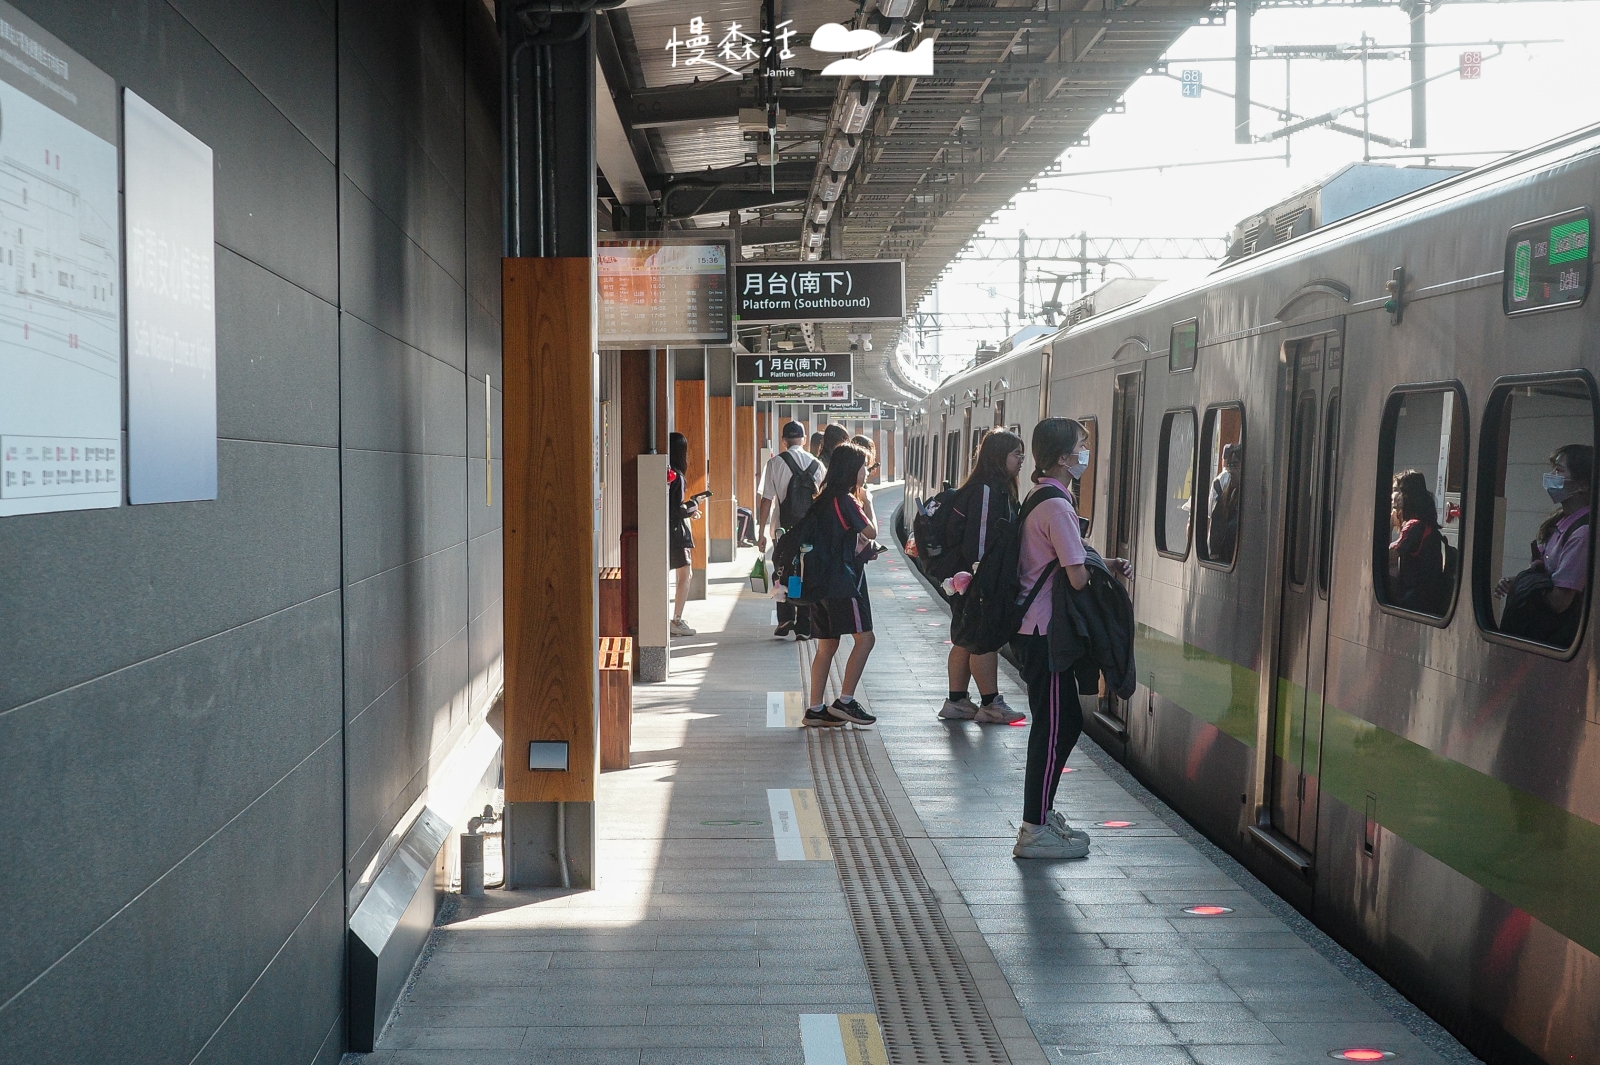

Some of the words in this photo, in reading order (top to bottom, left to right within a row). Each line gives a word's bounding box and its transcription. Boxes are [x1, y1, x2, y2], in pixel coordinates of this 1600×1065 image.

[1464, 52, 1481, 64] 68
[1183, 70, 1199, 82] 68
[1463, 66, 1480, 78] 42
[1182, 84, 1198, 96] 41
[742, 270, 853, 296] 月台(南下)
[743, 298, 791, 310] Platform
[794, 297, 871, 310] (Southbound)
[755, 359, 763, 378] 1
[770, 358, 827, 371] 月台(南下)
